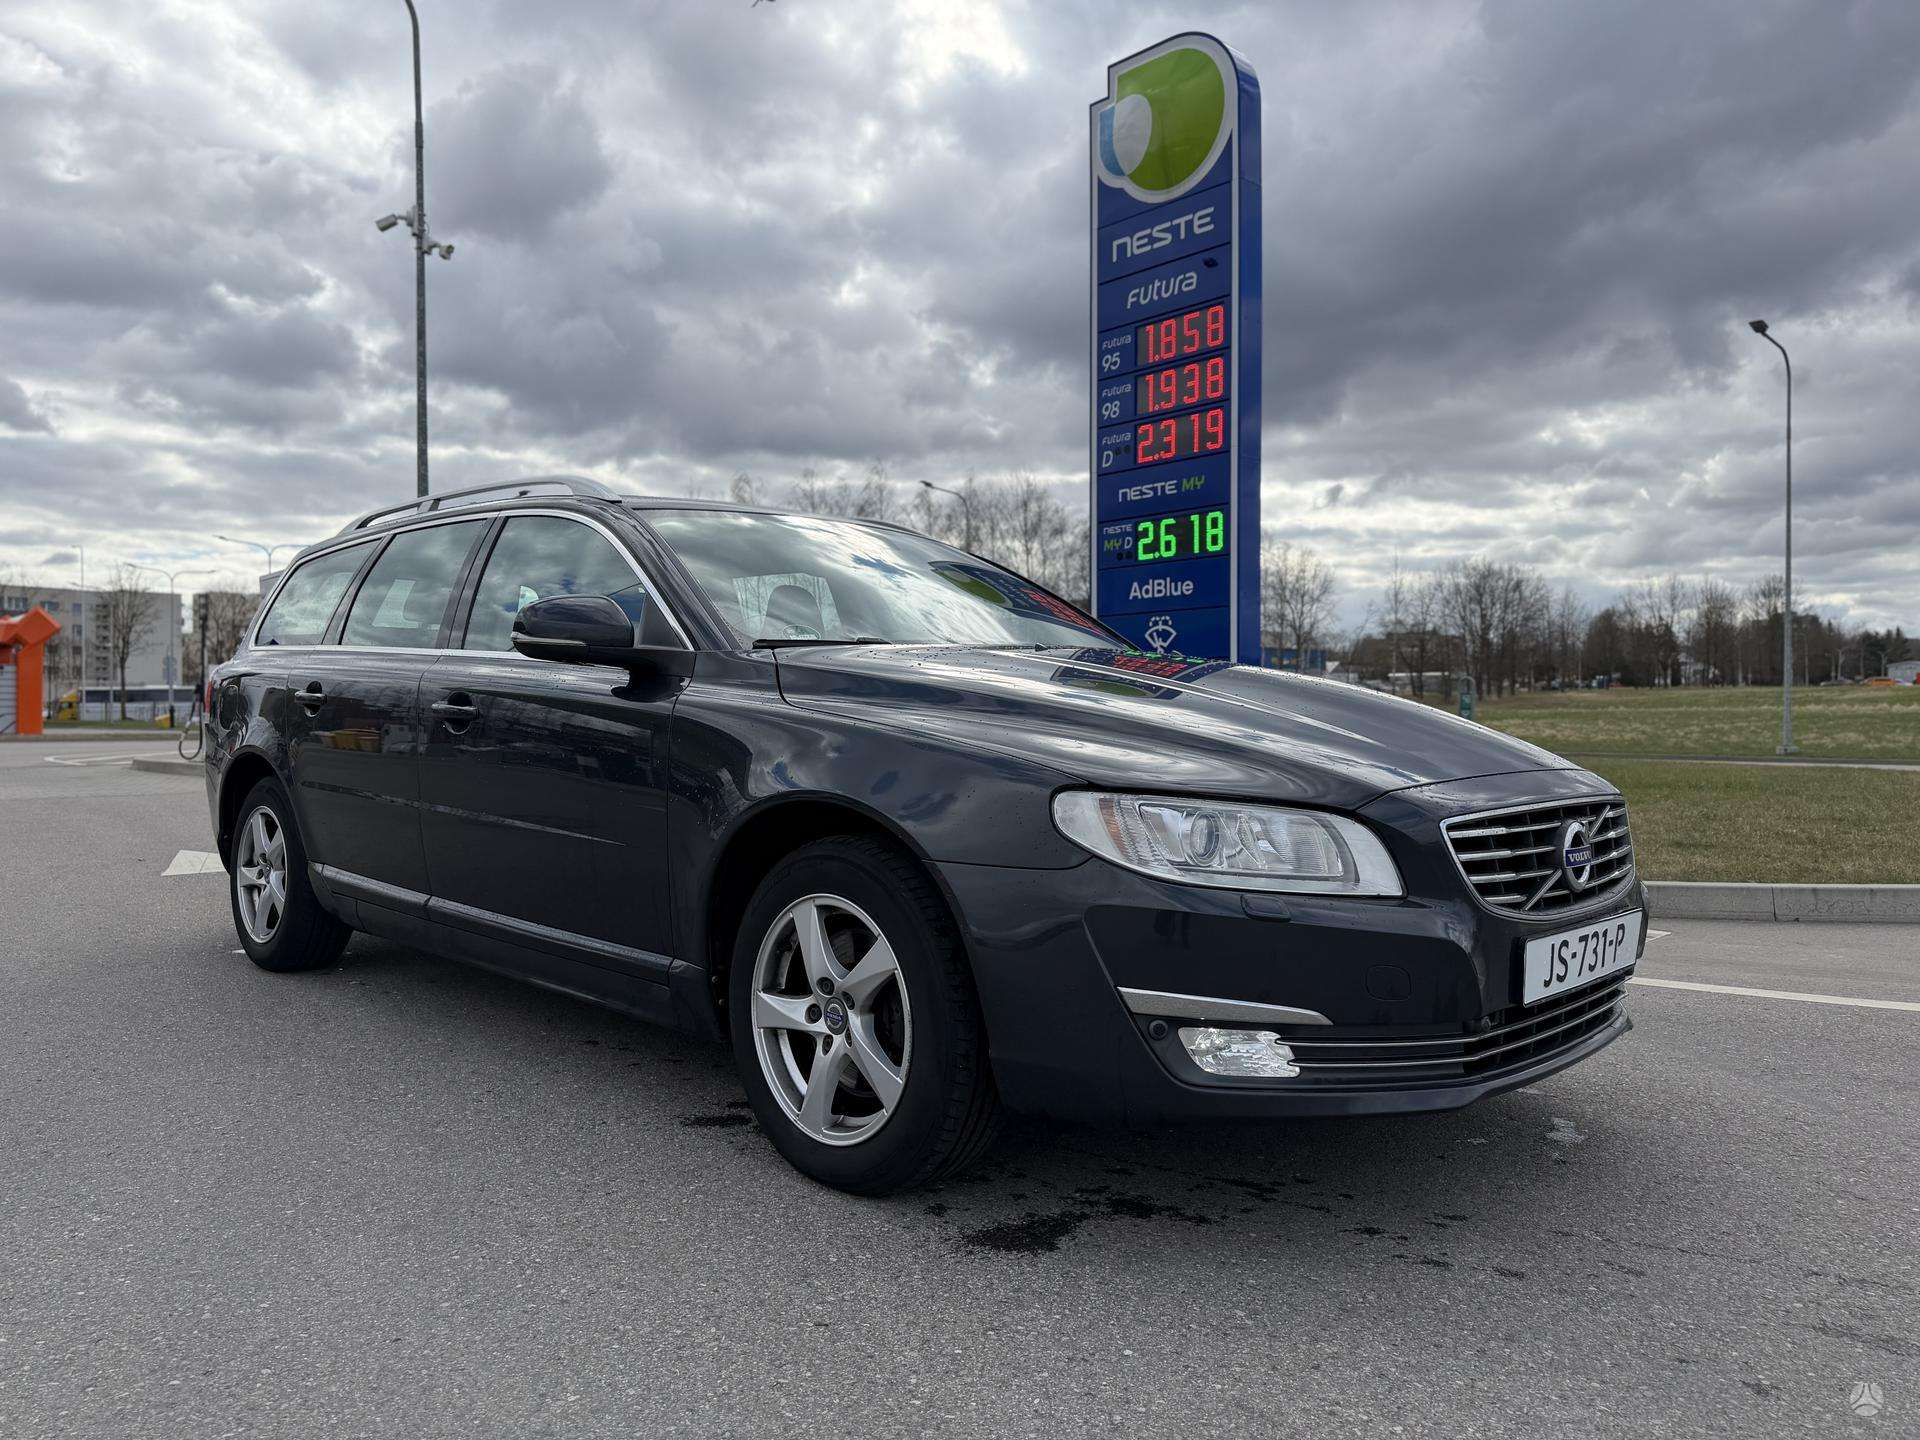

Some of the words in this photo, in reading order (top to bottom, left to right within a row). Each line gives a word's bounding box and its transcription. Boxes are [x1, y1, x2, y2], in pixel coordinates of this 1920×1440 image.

[1112, 206, 1215, 263] NESTE
[1126, 271, 1198, 309] Futura
[1102, 334, 1132, 350] Futura
[1145, 304, 1225, 363] 1.858
[1102, 352, 1121, 371] 95
[1102, 383, 1132, 398] Futura
[1145, 357, 1225, 413] 1.938
[1102, 402, 1120, 420] 98
[1137, 408, 1225, 464] 2.319
[1102, 450, 1114, 468] D
[1118, 479, 1178, 503] NESTE
[1182, 475, 1205, 492] MY
[1103, 523, 1133, 535] NESTE
[1137, 510, 1225, 562] 2.618
[1103, 539, 1121, 551] MY
[1124, 536, 1133, 549] D
[1129, 577, 1194, 600] AdBlue
[1568, 850, 1592, 862] VOLVO
[1543, 923, 1626, 988] JS-731-P
